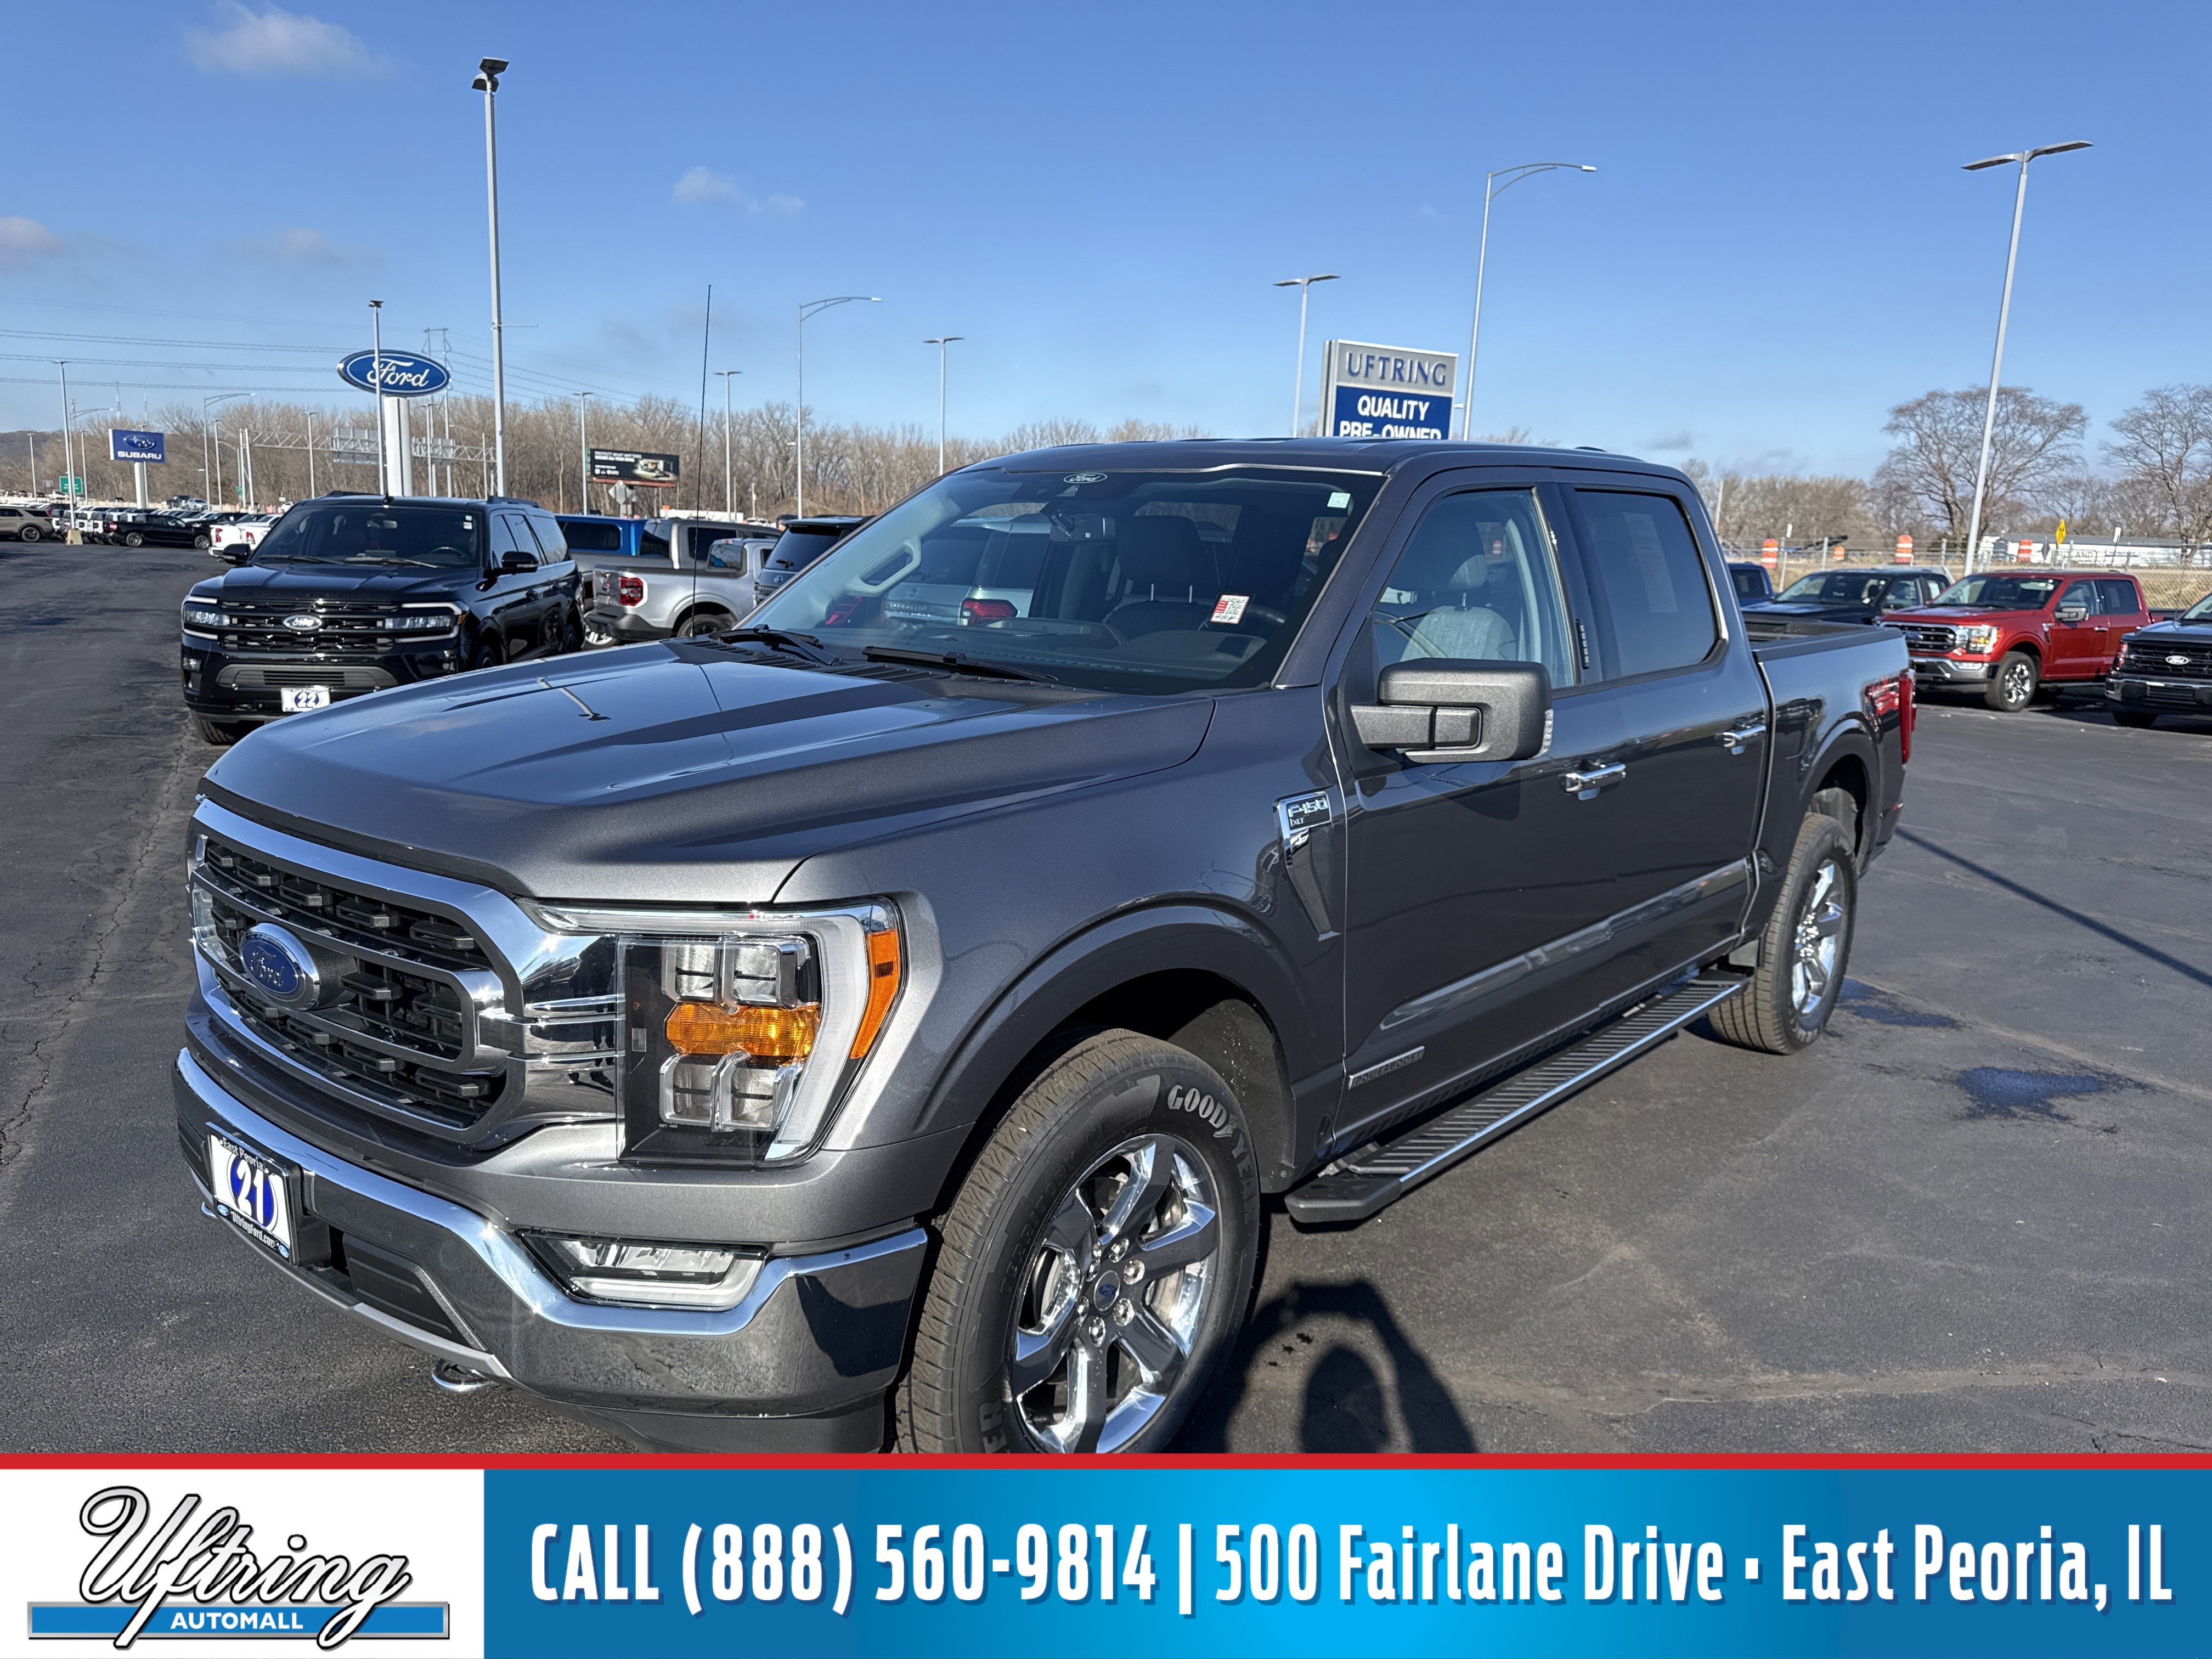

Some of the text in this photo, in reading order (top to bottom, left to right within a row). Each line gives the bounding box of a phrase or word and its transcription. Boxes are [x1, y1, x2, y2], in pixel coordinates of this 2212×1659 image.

[366, 358, 430, 388] Ford
[1346, 351, 1447, 386] UFTRING
[1357, 394, 1430, 421] QUALITY
[117, 451, 162, 460] SUBARU
[297, 692, 317, 708] 22
[1288, 798, 1328, 818] F-150
[222, 1137, 264, 1172] East Peoria
[1167, 1085, 1258, 1224] GOODYEAR
[236, 1159, 264, 1225] 21
